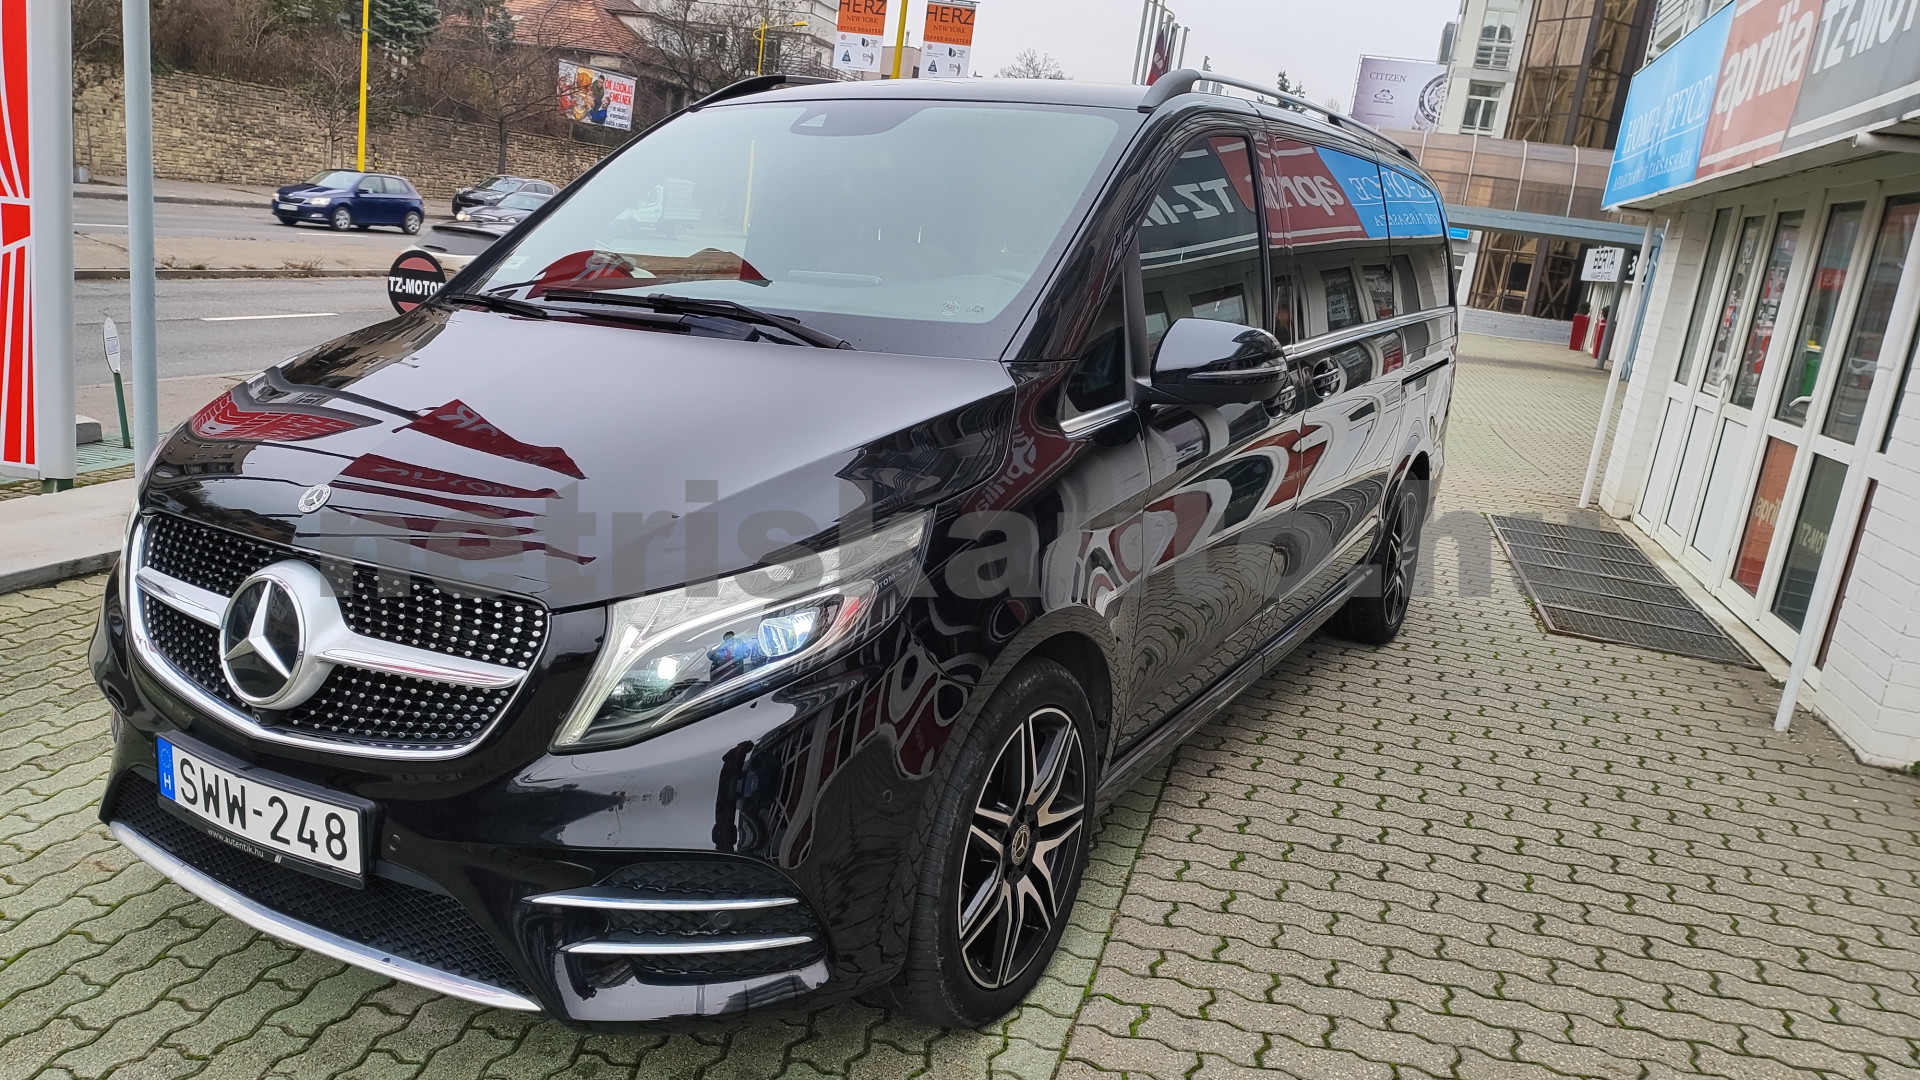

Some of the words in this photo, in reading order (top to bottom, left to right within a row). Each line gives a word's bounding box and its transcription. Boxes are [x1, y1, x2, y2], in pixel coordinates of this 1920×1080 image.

[838, 0, 887, 15] HERZ
[926, 4, 976, 25] HERZ
[861, 16, 879, 24] YORK
[933, 24, 948, 32] NEW
[948, 25, 966, 33] YORK
[1715, 0, 1813, 131] aprilia
[1369, 71, 1407, 82] CITIZEN
[163, 772, 172, 791] H
[180, 757, 348, 861] SWW-248
[207, 827, 264, 858] www.autentik.hu
